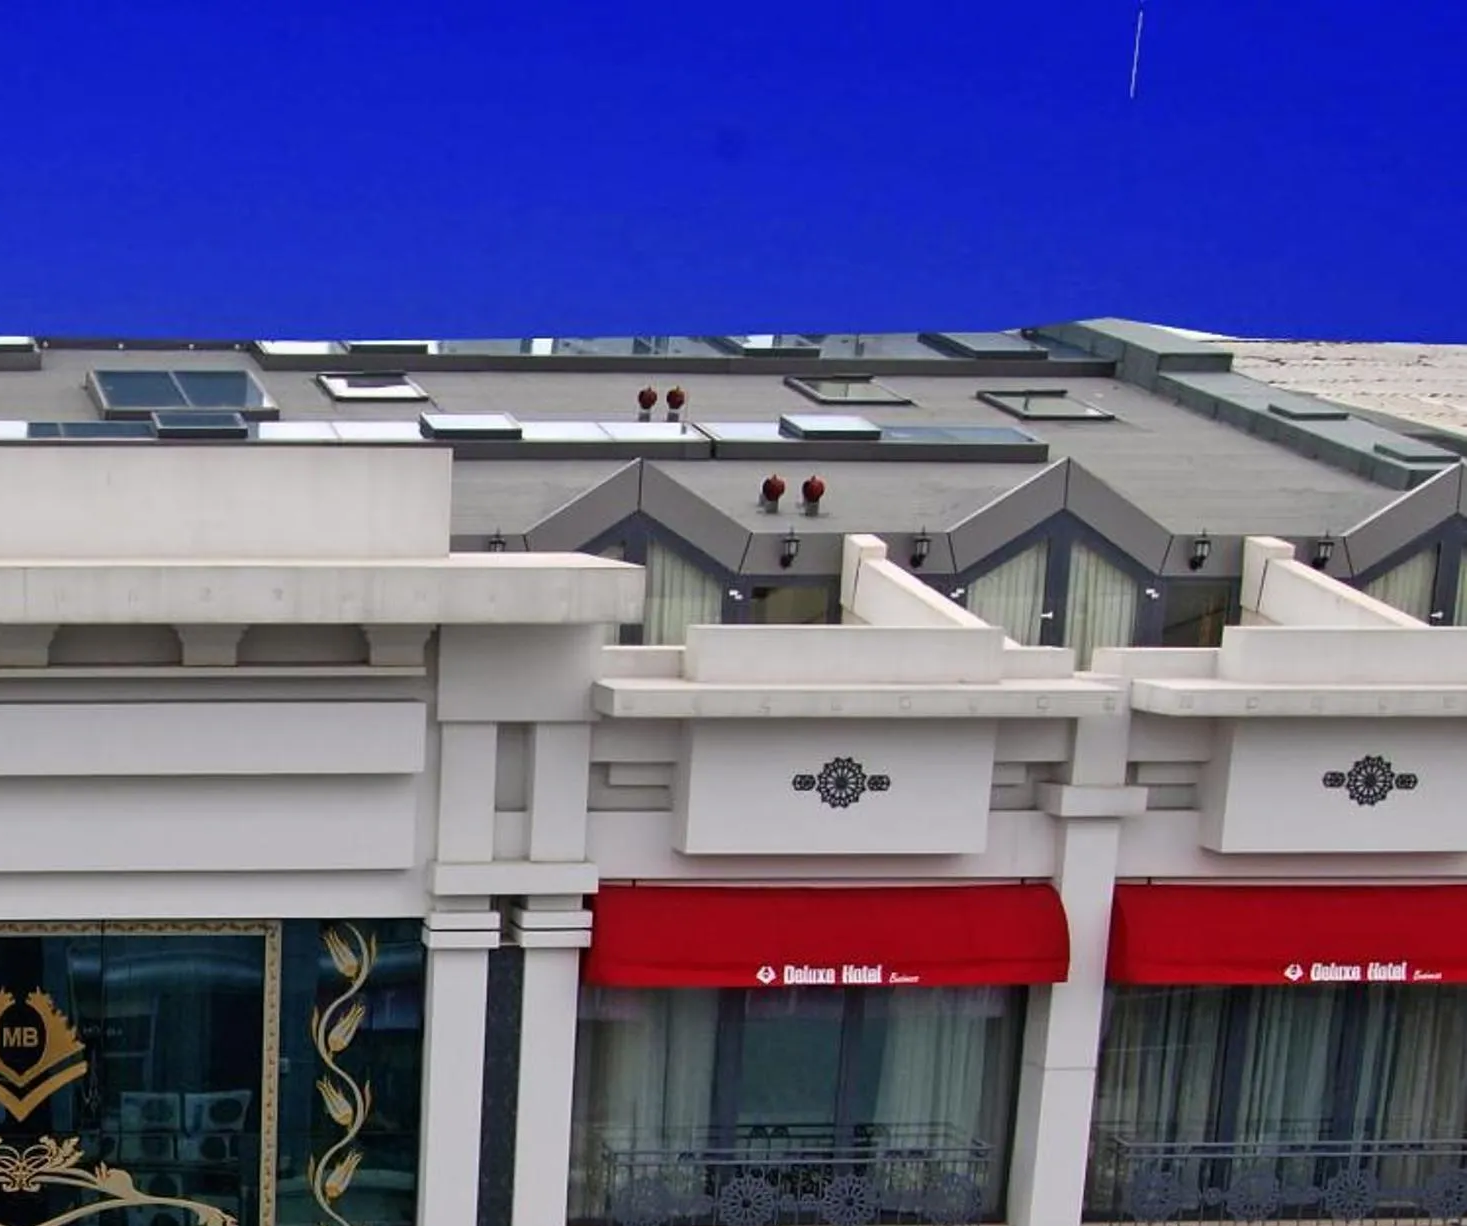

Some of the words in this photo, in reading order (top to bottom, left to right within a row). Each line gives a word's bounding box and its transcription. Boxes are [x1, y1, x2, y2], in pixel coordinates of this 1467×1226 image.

[783, 964, 835, 985] Deluxe
[842, 964, 882, 984] Hotel
[1310, 962, 1361, 981] Deluxe
[1366, 961, 1407, 981] Hotel
[2, 1026, 39, 1048] MB
